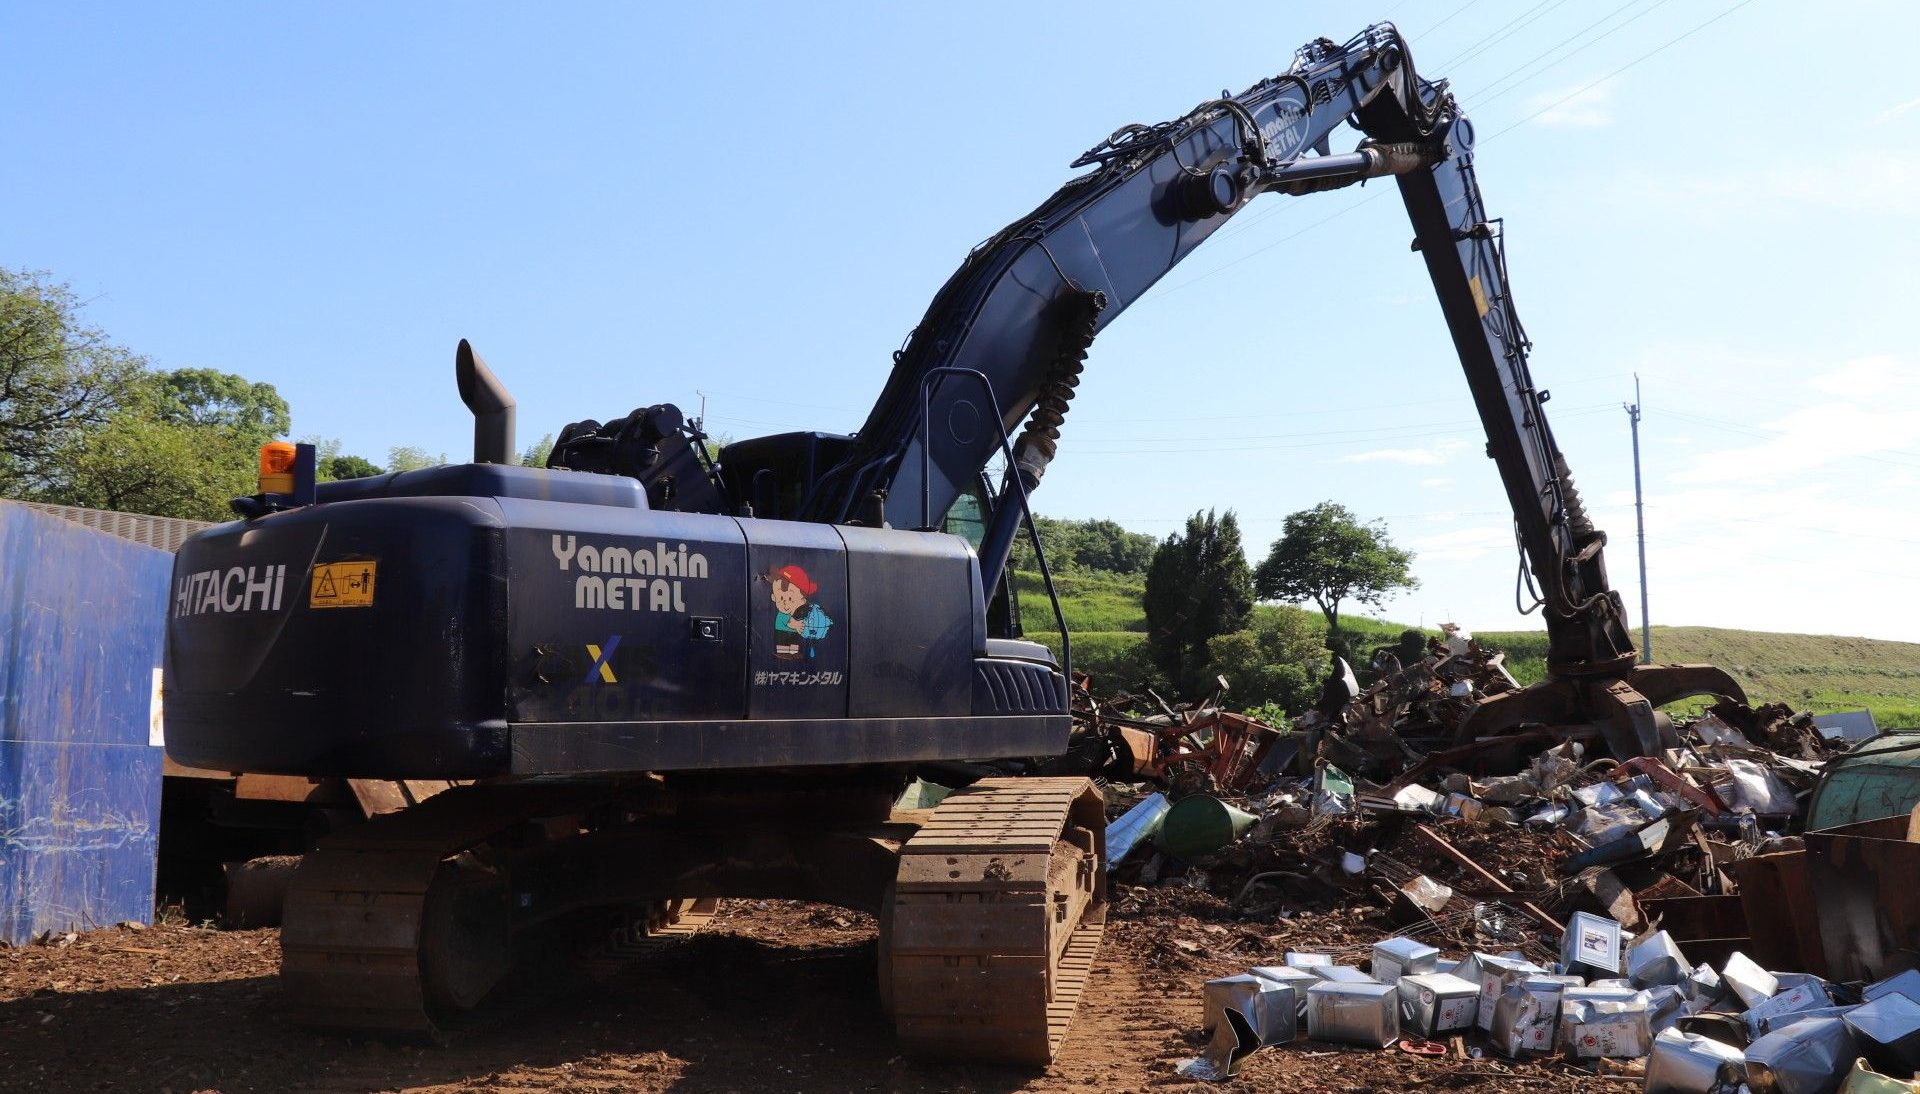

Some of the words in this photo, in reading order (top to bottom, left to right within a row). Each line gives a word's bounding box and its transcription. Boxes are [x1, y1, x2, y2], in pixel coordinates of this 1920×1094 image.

[552, 534, 708, 578] Yamakin
[175, 565, 286, 618] HITACHI
[575, 575, 686, 613] METAL
